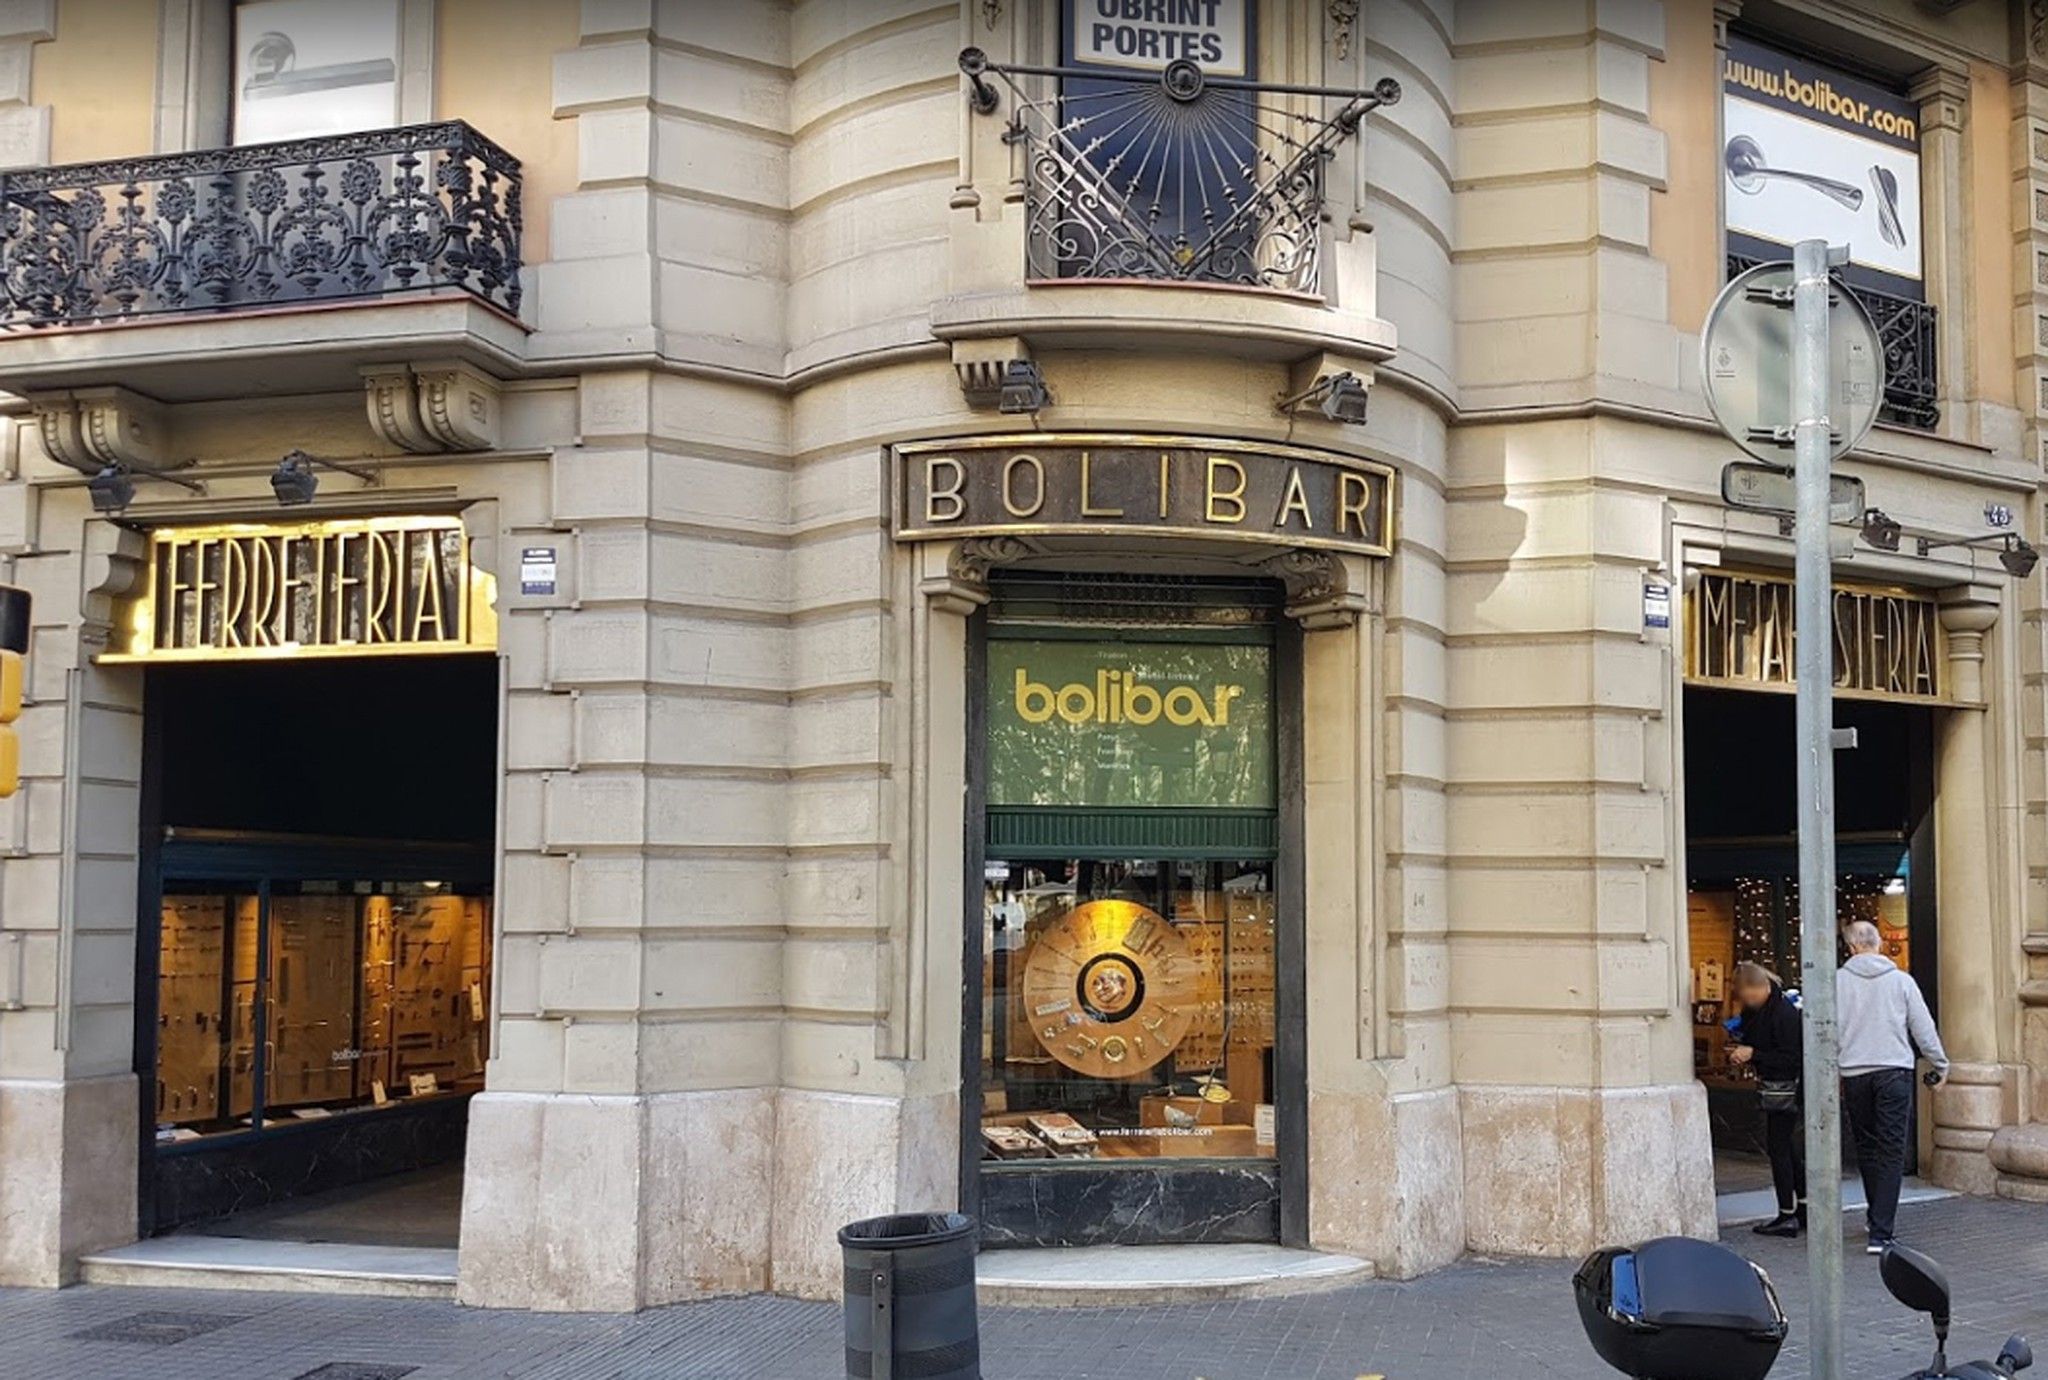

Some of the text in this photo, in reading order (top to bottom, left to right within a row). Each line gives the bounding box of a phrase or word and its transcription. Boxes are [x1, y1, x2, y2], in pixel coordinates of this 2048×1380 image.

[1093, 23, 1222, 63] PORTES
[926, 452, 1370, 537] BOLIBAR
[170, 528, 444, 648] FERRETERIA
[1015, 668, 1245, 726] bolibar
